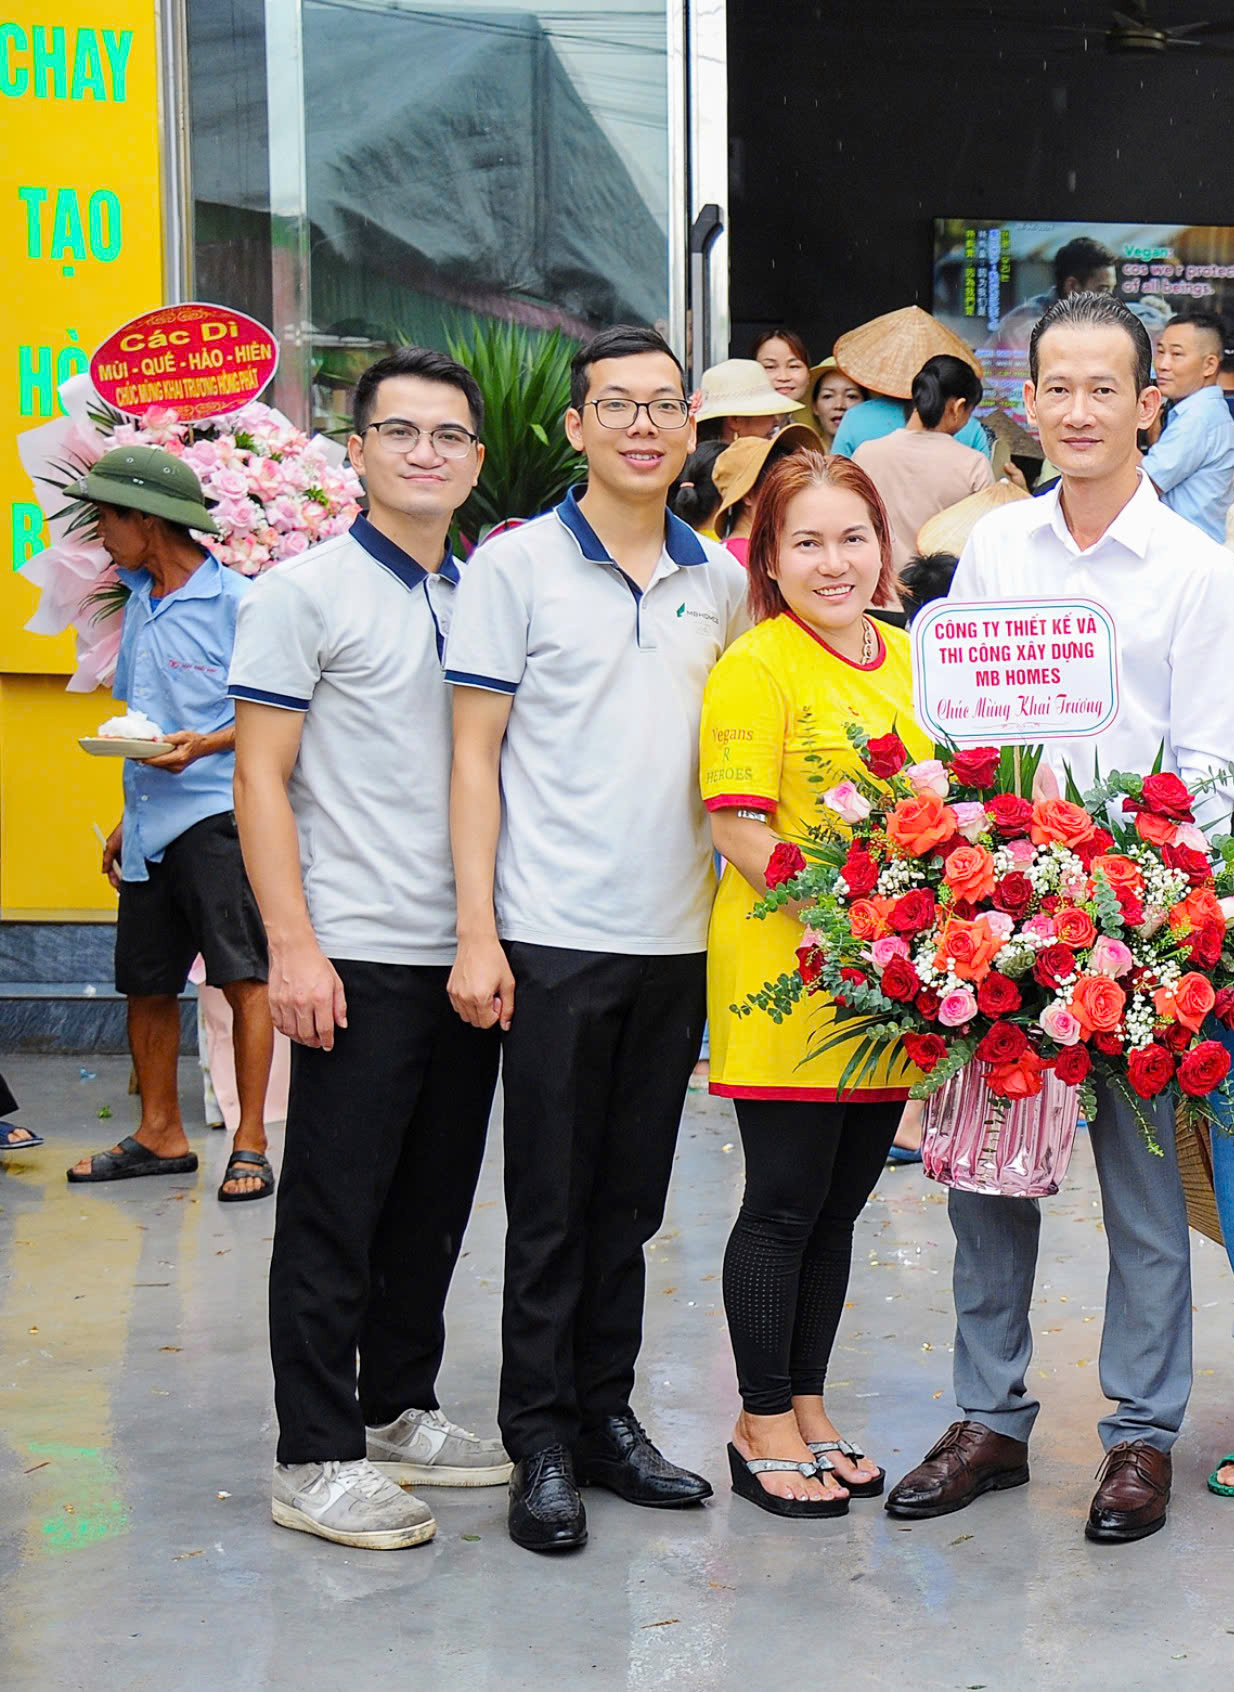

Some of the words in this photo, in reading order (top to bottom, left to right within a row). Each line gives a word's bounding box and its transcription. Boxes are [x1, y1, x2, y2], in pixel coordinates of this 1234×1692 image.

[0, 22, 134, 102] CHAY
[18, 186, 122, 277] TẠO
[120, 329, 191, 352] Các
[201, 321, 239, 341] Dì
[935, 619, 977, 639] CÔNG
[982, 620, 999, 638] TY
[1005, 612, 1047, 637] THIẾT
[1052, 611, 1072, 635] KẾ
[1076, 613, 1097, 634] VÀ
[939, 647, 963, 664] THI
[968, 642, 1011, 663] CÔNG
[1016, 640, 1046, 661] XÂY
[1051, 641, 1095, 663] DỰNG
[975, 670, 1000, 687] MB
[1005, 667, 1061, 686] HOMES
[937, 698, 969, 720] Chúc
[1016, 695, 1051, 717] Khai
[711, 726, 754, 745] Vegans
[705, 767, 753, 784] HEROES
